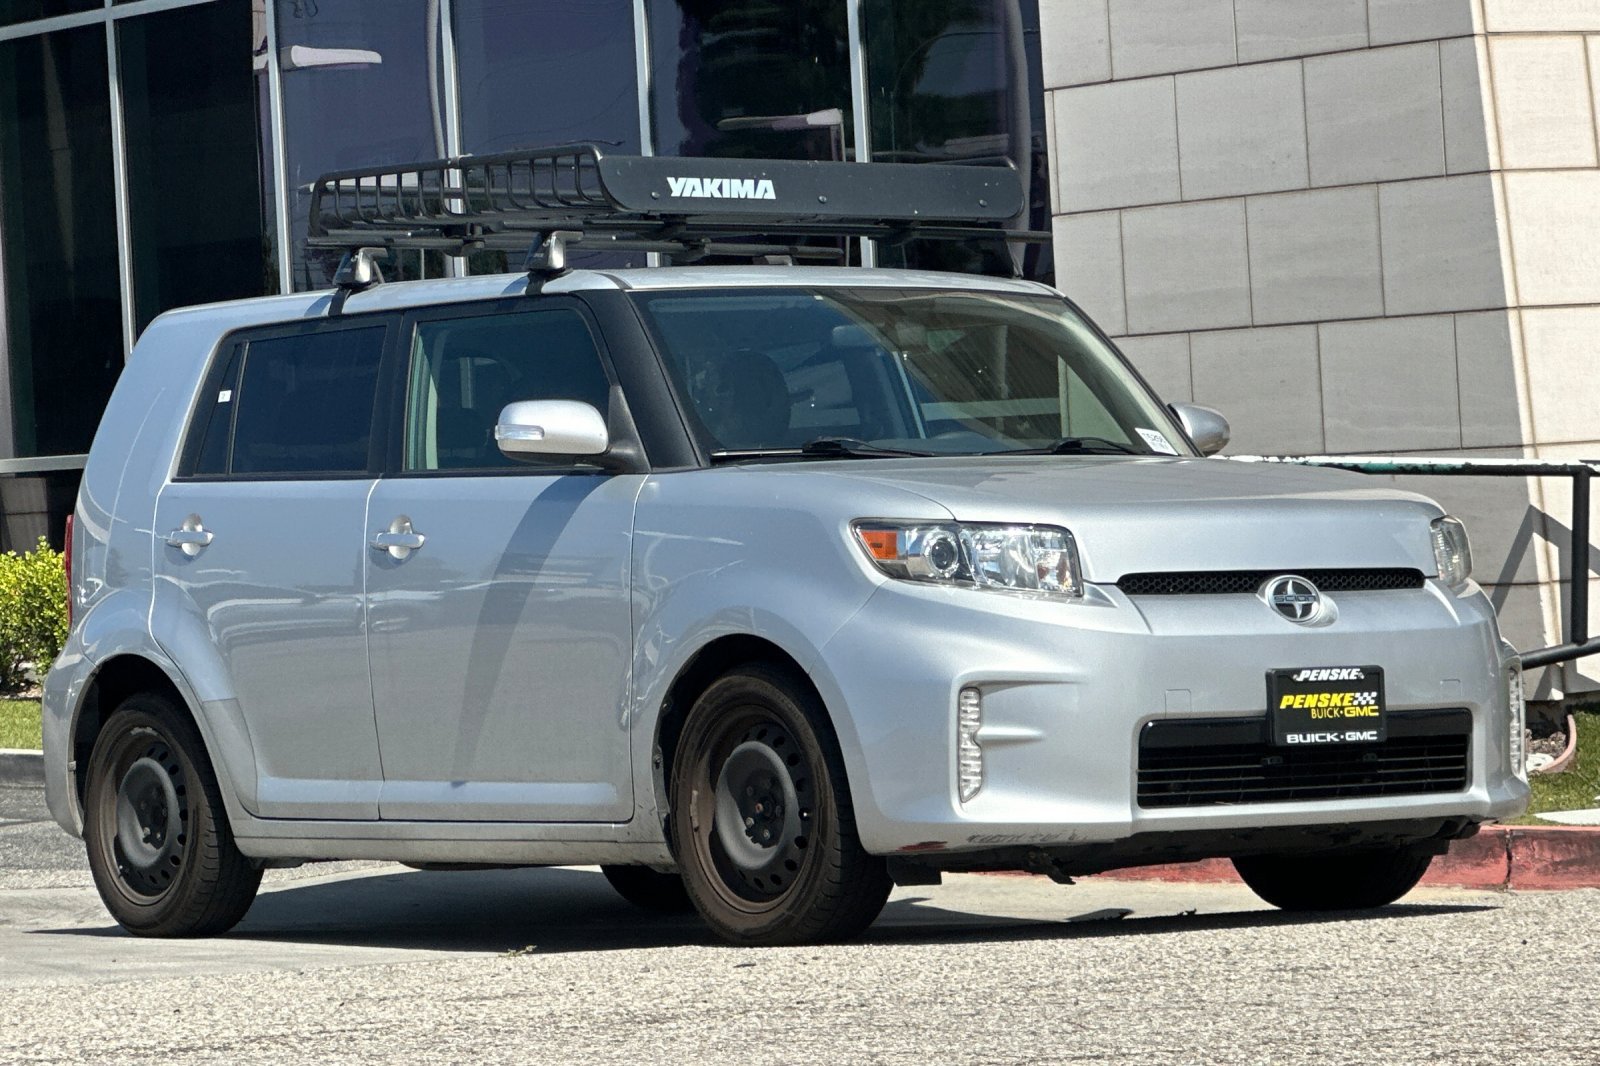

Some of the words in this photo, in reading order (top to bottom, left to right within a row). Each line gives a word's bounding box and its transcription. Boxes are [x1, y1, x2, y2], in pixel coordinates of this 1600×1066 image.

[666, 177, 776, 199] YAKIMA
[1296, 668, 1361, 682] PENSKE
[1279, 693, 1355, 709] PENSKE
